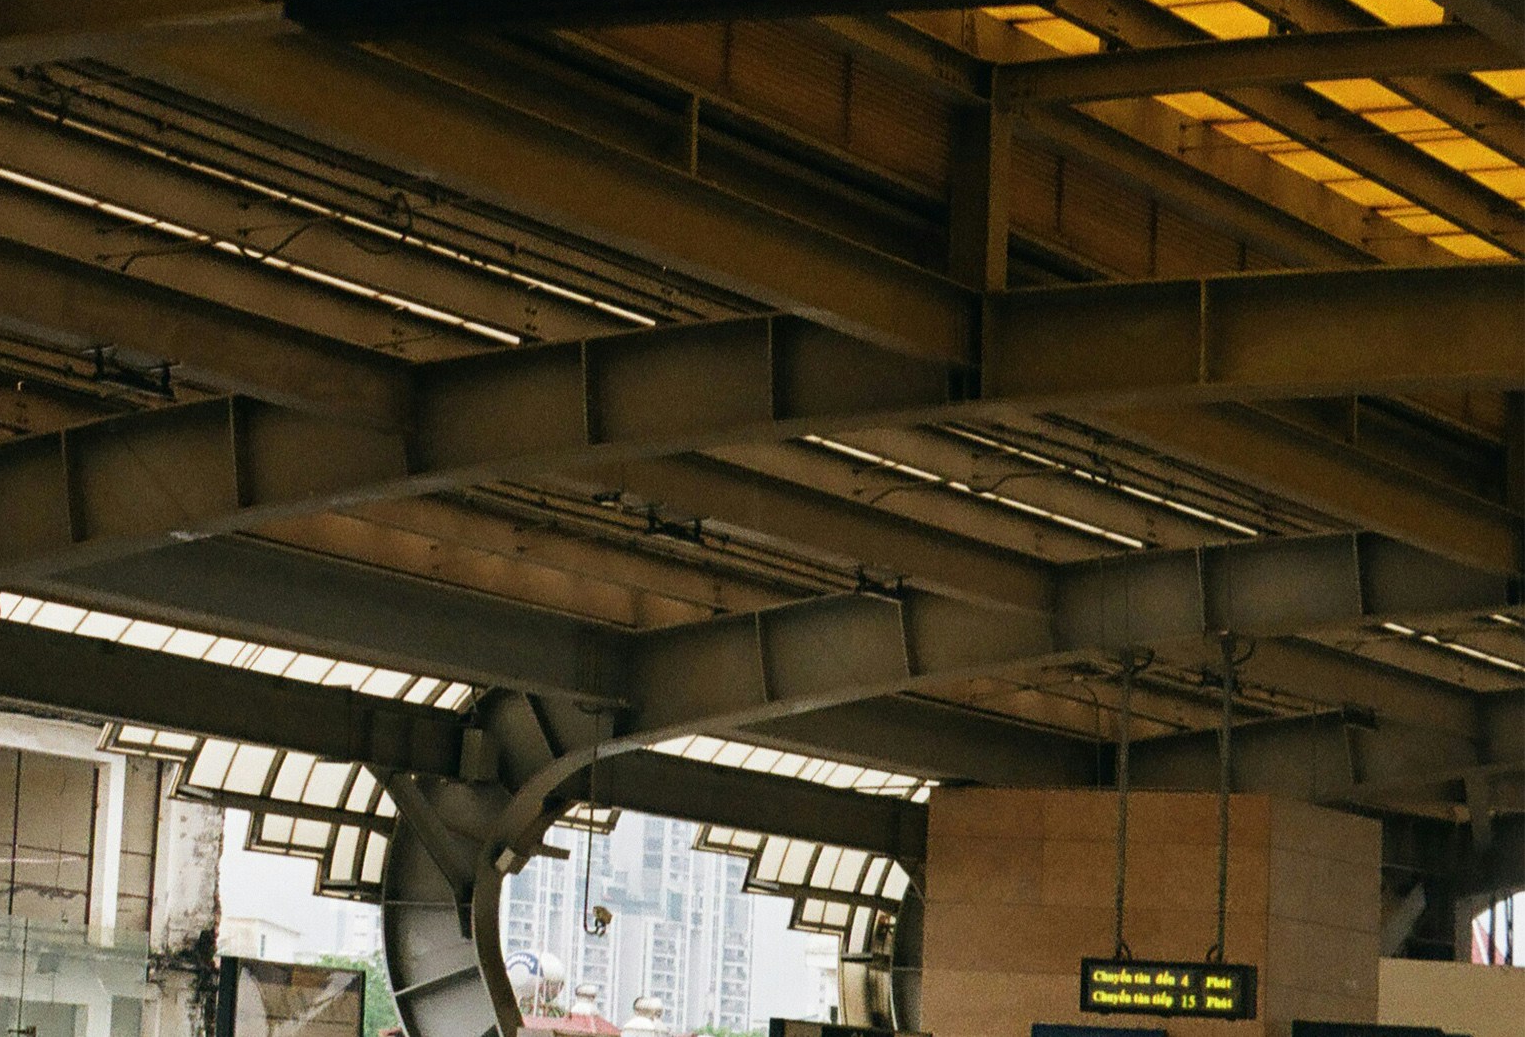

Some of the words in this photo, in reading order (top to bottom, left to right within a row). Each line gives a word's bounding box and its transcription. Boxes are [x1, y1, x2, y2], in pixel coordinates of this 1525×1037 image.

[1180, 974, 1190, 988] 4
[1205, 976, 1232, 989] Phút
[1181, 994, 1197, 1009] 15
[1205, 995, 1233, 1010] Phút
